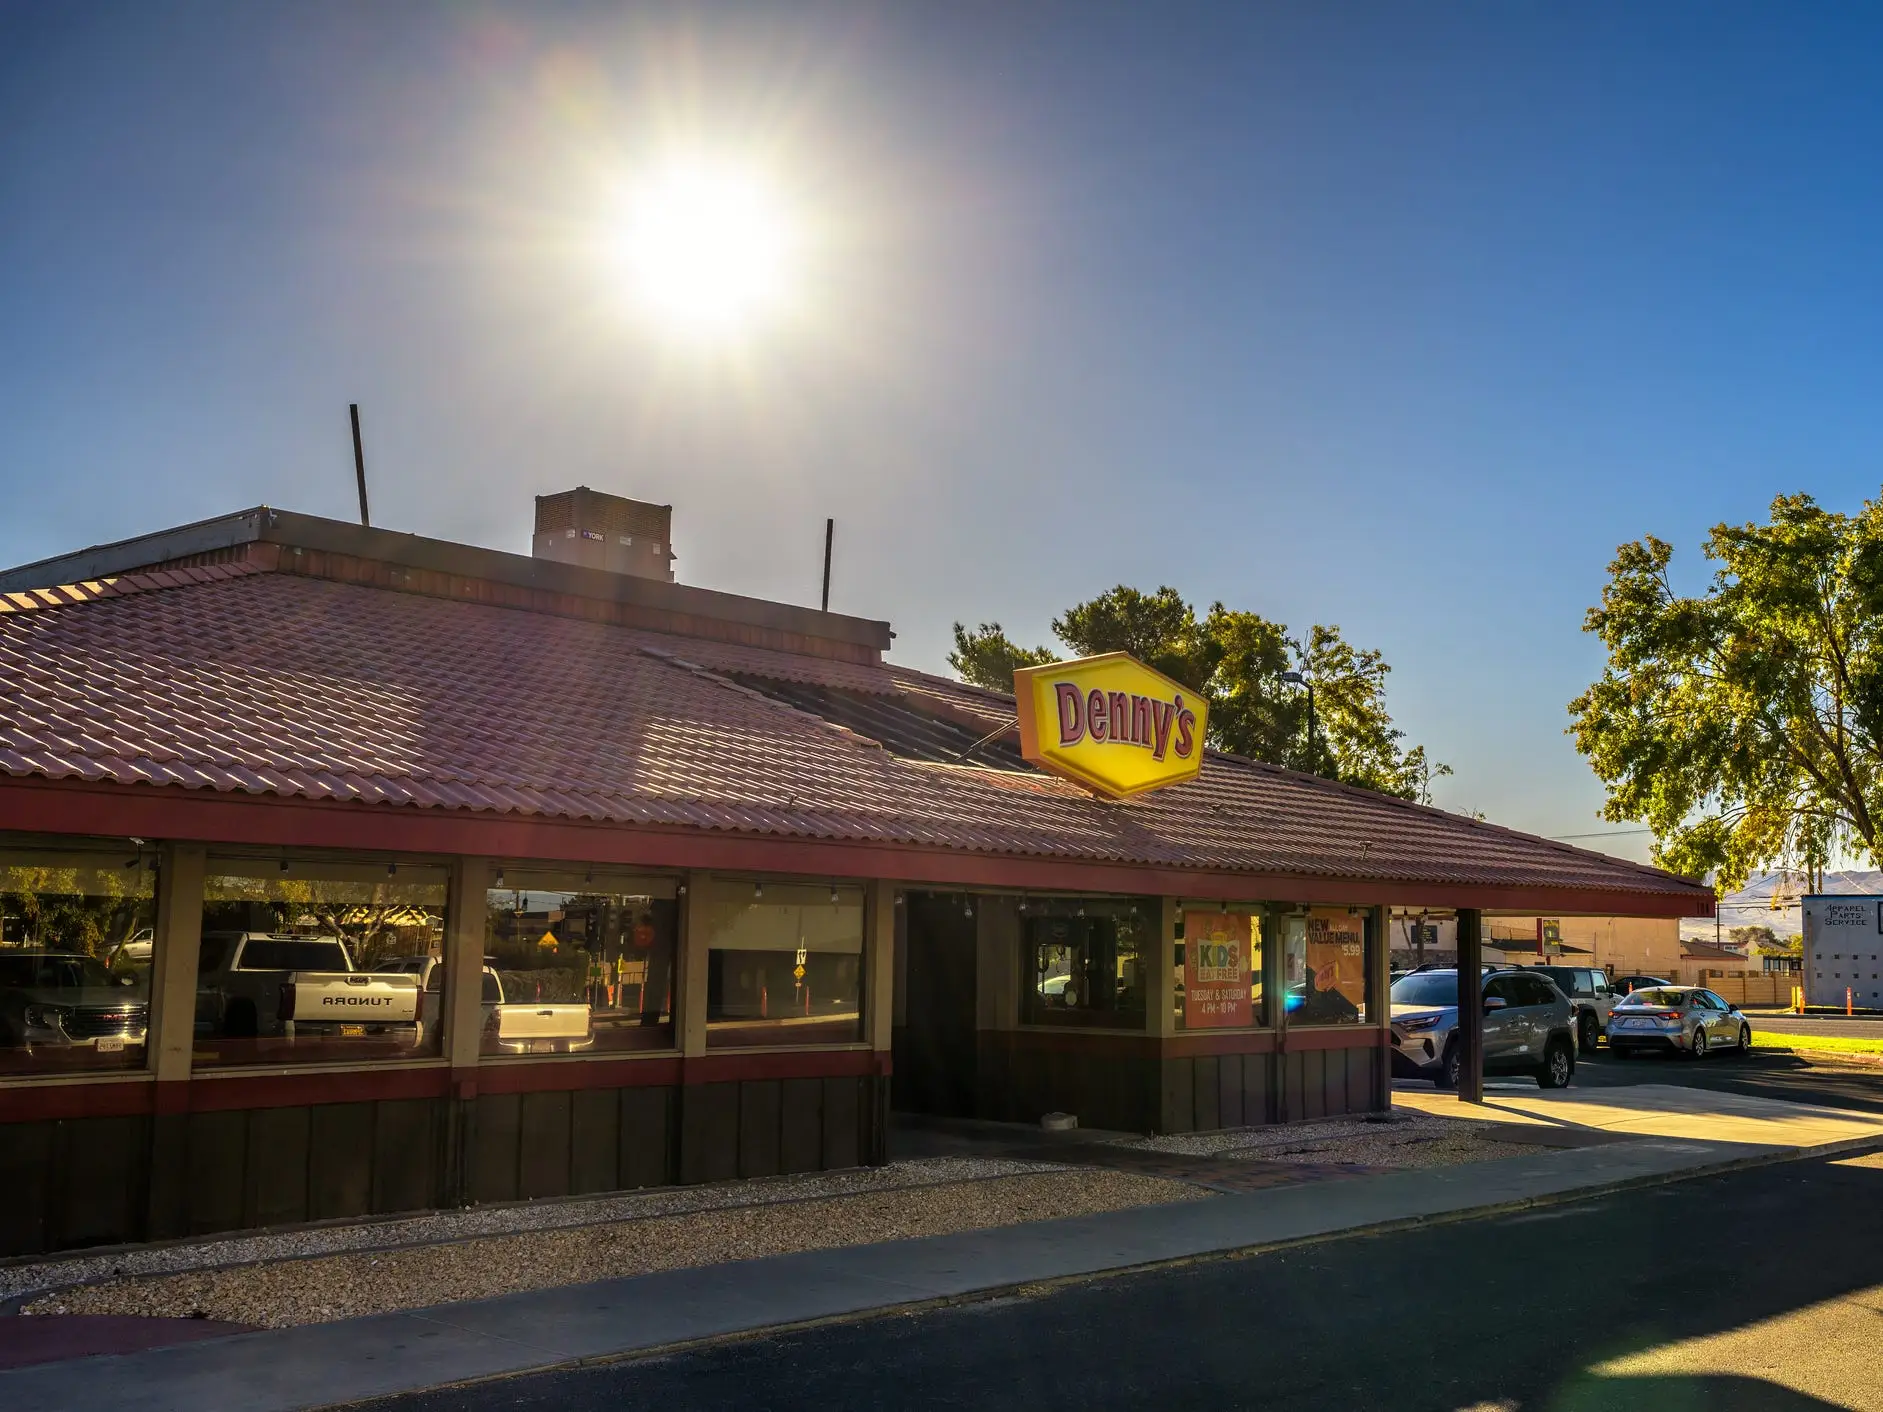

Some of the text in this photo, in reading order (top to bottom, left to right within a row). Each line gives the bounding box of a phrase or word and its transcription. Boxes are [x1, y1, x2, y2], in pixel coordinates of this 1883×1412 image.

[588, 532, 604, 542] YORK
[1053, 681, 1196, 764] Denny's
[1825, 904, 1867, 912] APPAREL
[1830, 911, 1862, 919] PARTS
[1308, 918, 1329, 932] NEW
[1825, 918, 1868, 926] SERVICE
[1309, 932, 1334, 944] VALUE
[1199, 944, 1239, 968] KIDS
[1217, 968, 1238, 980] FREE
[1191, 989, 1214, 1001] TUESDAY
[1221, 989, 1247, 1001] SATURDAY
[1207, 1003, 1216, 1014] PM
